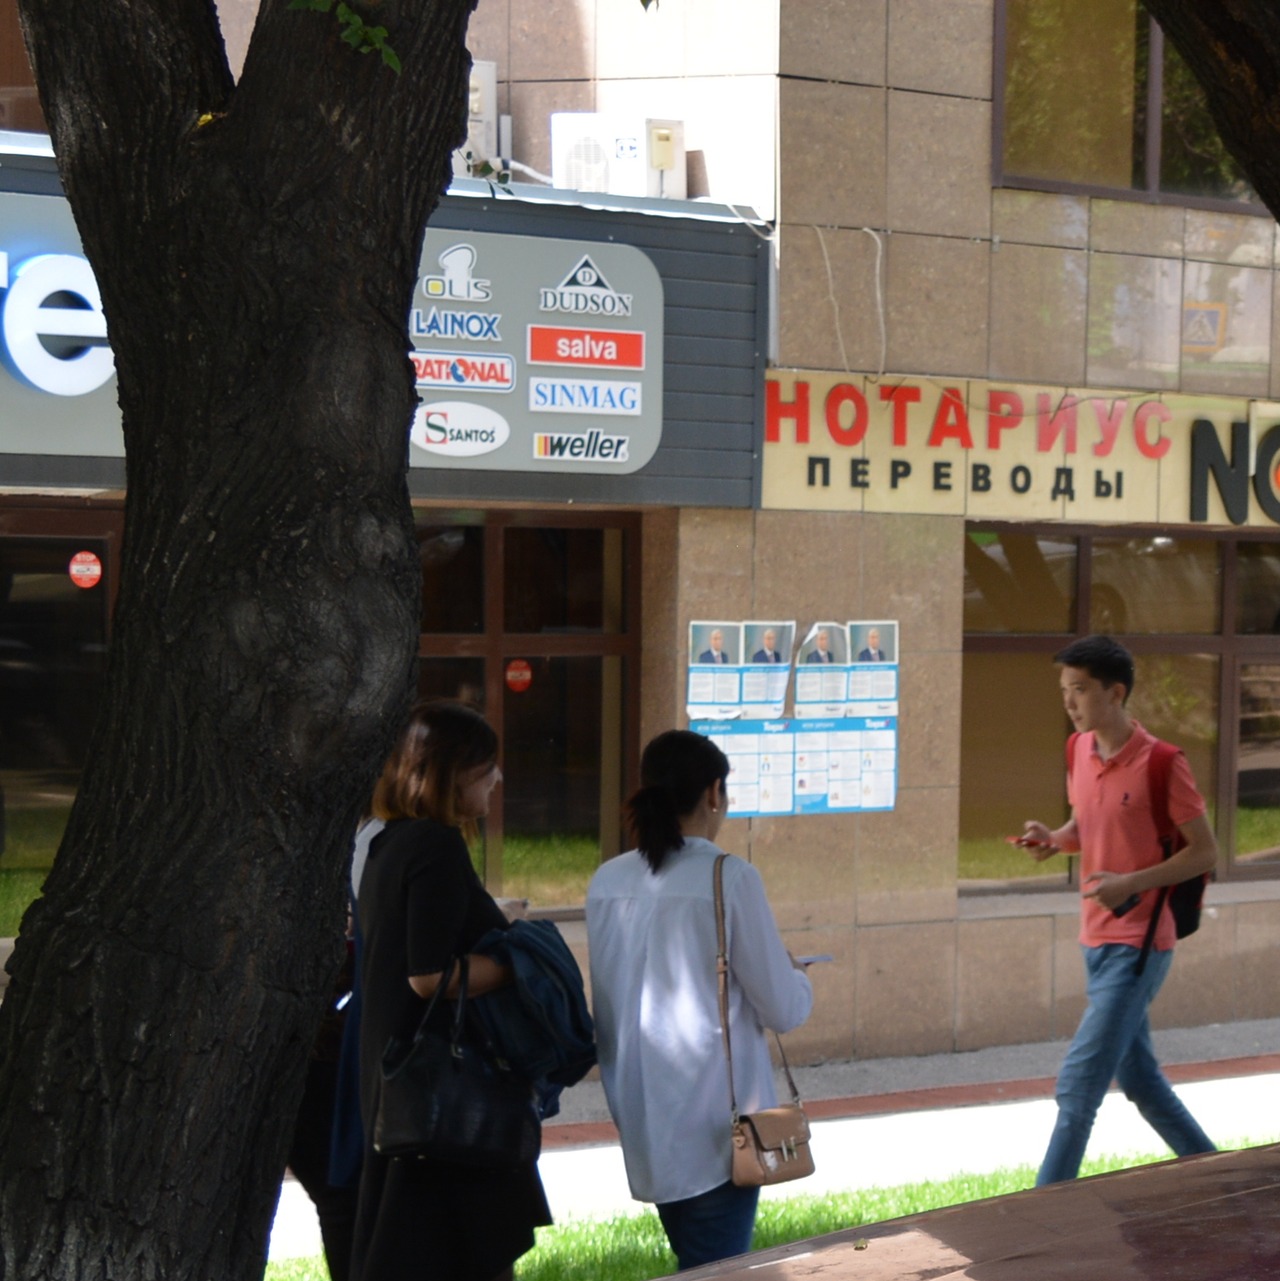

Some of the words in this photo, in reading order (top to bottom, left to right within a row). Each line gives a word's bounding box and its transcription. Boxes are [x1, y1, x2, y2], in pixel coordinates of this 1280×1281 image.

[542, 290, 632, 315] DUDSON
[415, 310, 499, 339] LAINOX
[556, 334, 618, 361] salva
[534, 382, 637, 412] SINMAG
[764, 379, 1172, 459] НОТАРИУС
[449, 427, 496, 444] SANTOS
[550, 430, 627, 460] weller
[807, 457, 1123, 501] ПЕРЕВОДЫ
